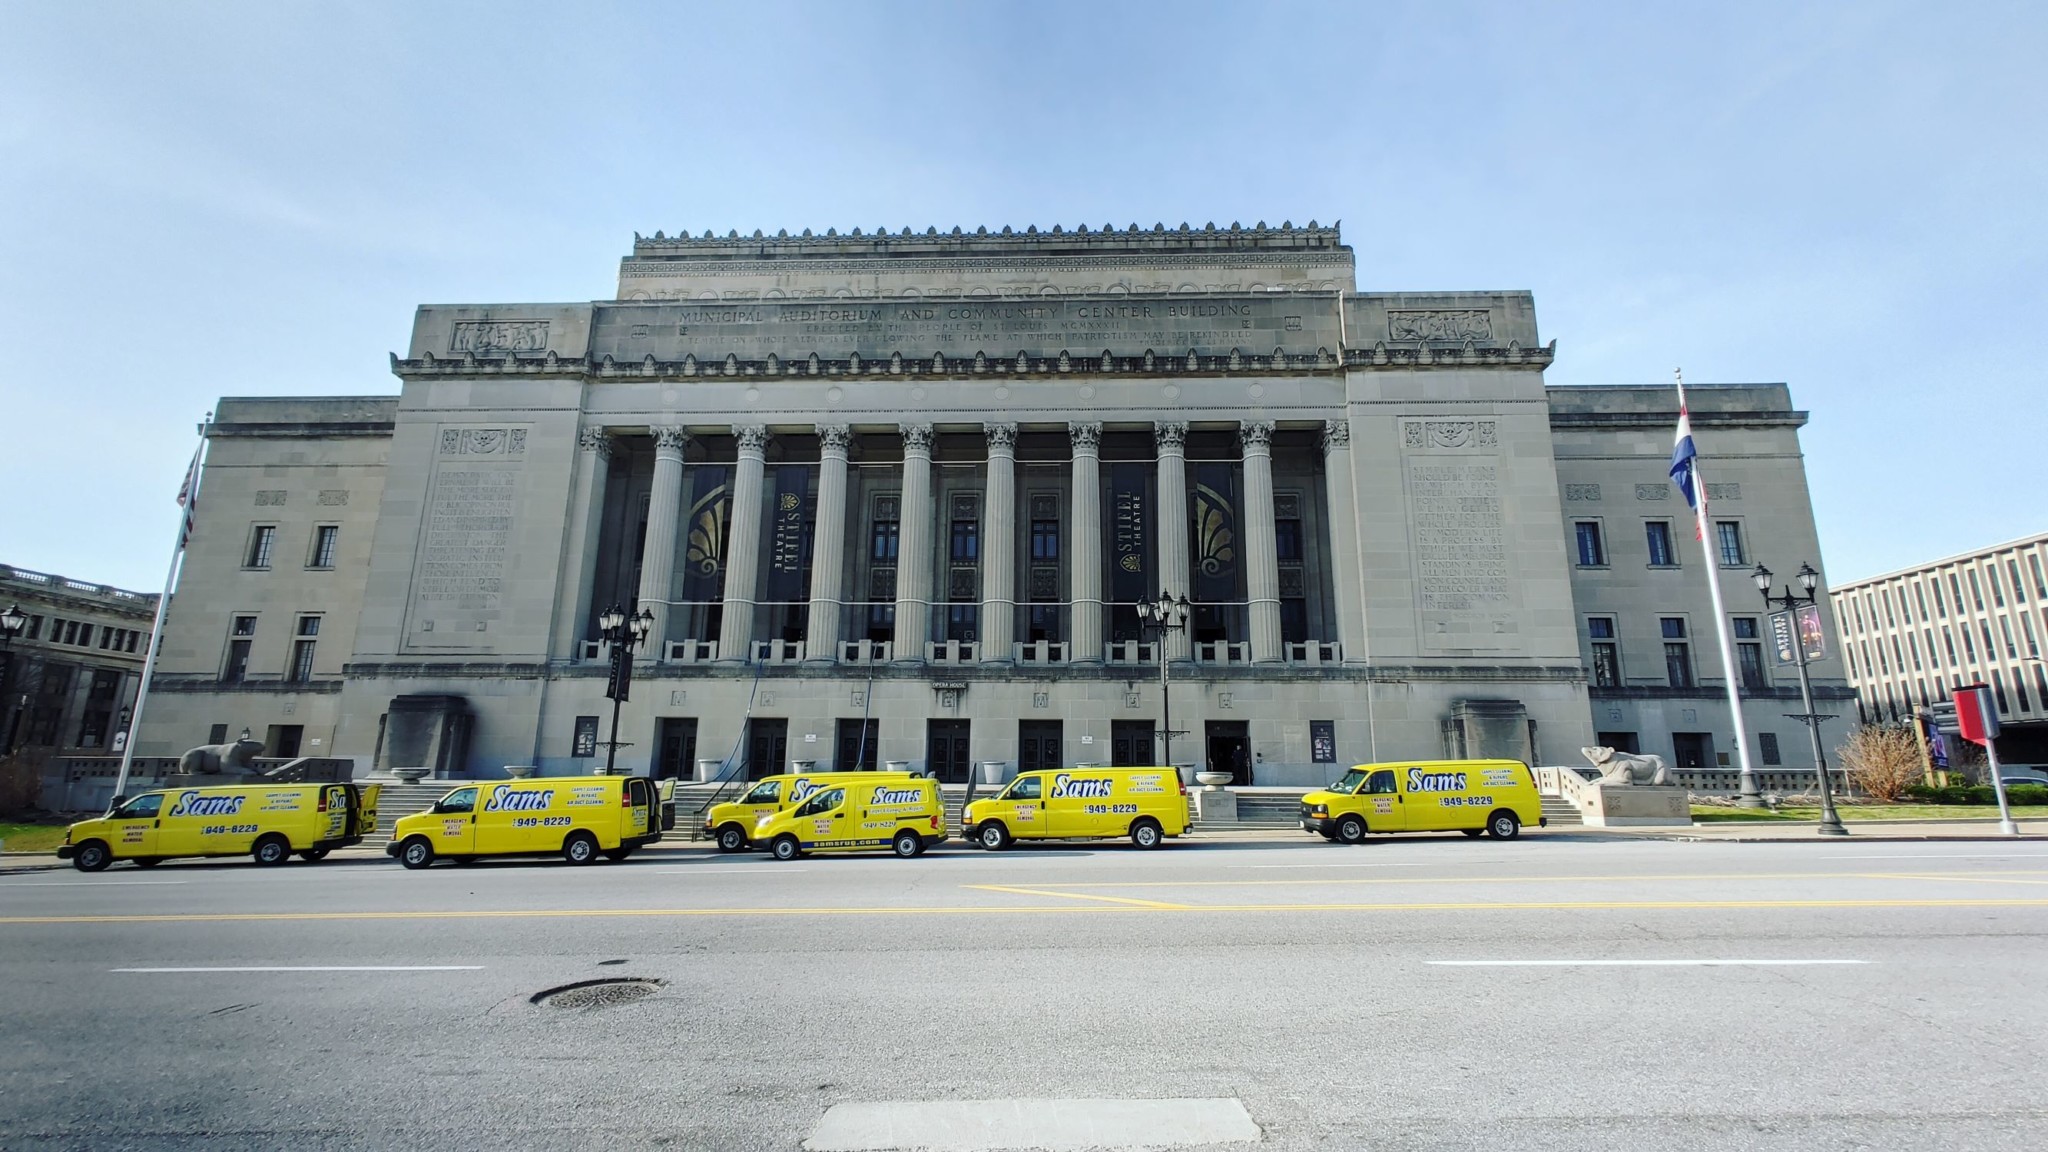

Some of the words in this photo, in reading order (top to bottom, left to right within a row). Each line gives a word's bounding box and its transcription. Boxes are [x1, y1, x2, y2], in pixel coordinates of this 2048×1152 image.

[680, 311, 763, 322] MUNICIPAL
[779, 309, 882, 322] AUDITORIUM
[901, 309, 934, 320] AND
[948, 307, 1058, 319] COMMUNITY
[1078, 306, 1154, 318] CENTER
[1168, 305, 1251, 317] BUILDING
[971, 323, 982, 331] OF
[1061, 321, 1119, 330] MCMXXXII
[875, 334, 925, 342] GLOWING
[935, 334, 953, 342] THE
[1028, 333, 1062, 341] WHICH
[1071, 332, 1137, 340] PATRIOTISM
[1144, 331, 1165, 340] MAY
[1189, 331, 1252, 339] REKINDLED
[1117, 491, 1133, 552] STIFEL
[1133, 496, 1141, 547] THEATRE
[775, 518, 785, 569] THEATRE
[784, 513, 800, 573] STIFEL
[1050, 773, 1113, 798] Sams
[1407, 767, 1466, 792] Sams
[170, 790, 246, 817] Sams
[485, 784, 554, 812] Sams
[870, 787, 921, 806] Sams
[1444, 796, 1493, 806] 949-8229
[1088, 804, 1137, 813] 949-8229
[205, 824, 259, 835] 949-8229
[517, 816, 572, 827] 949-8229
[813, 839, 881, 847] samsrug.com
